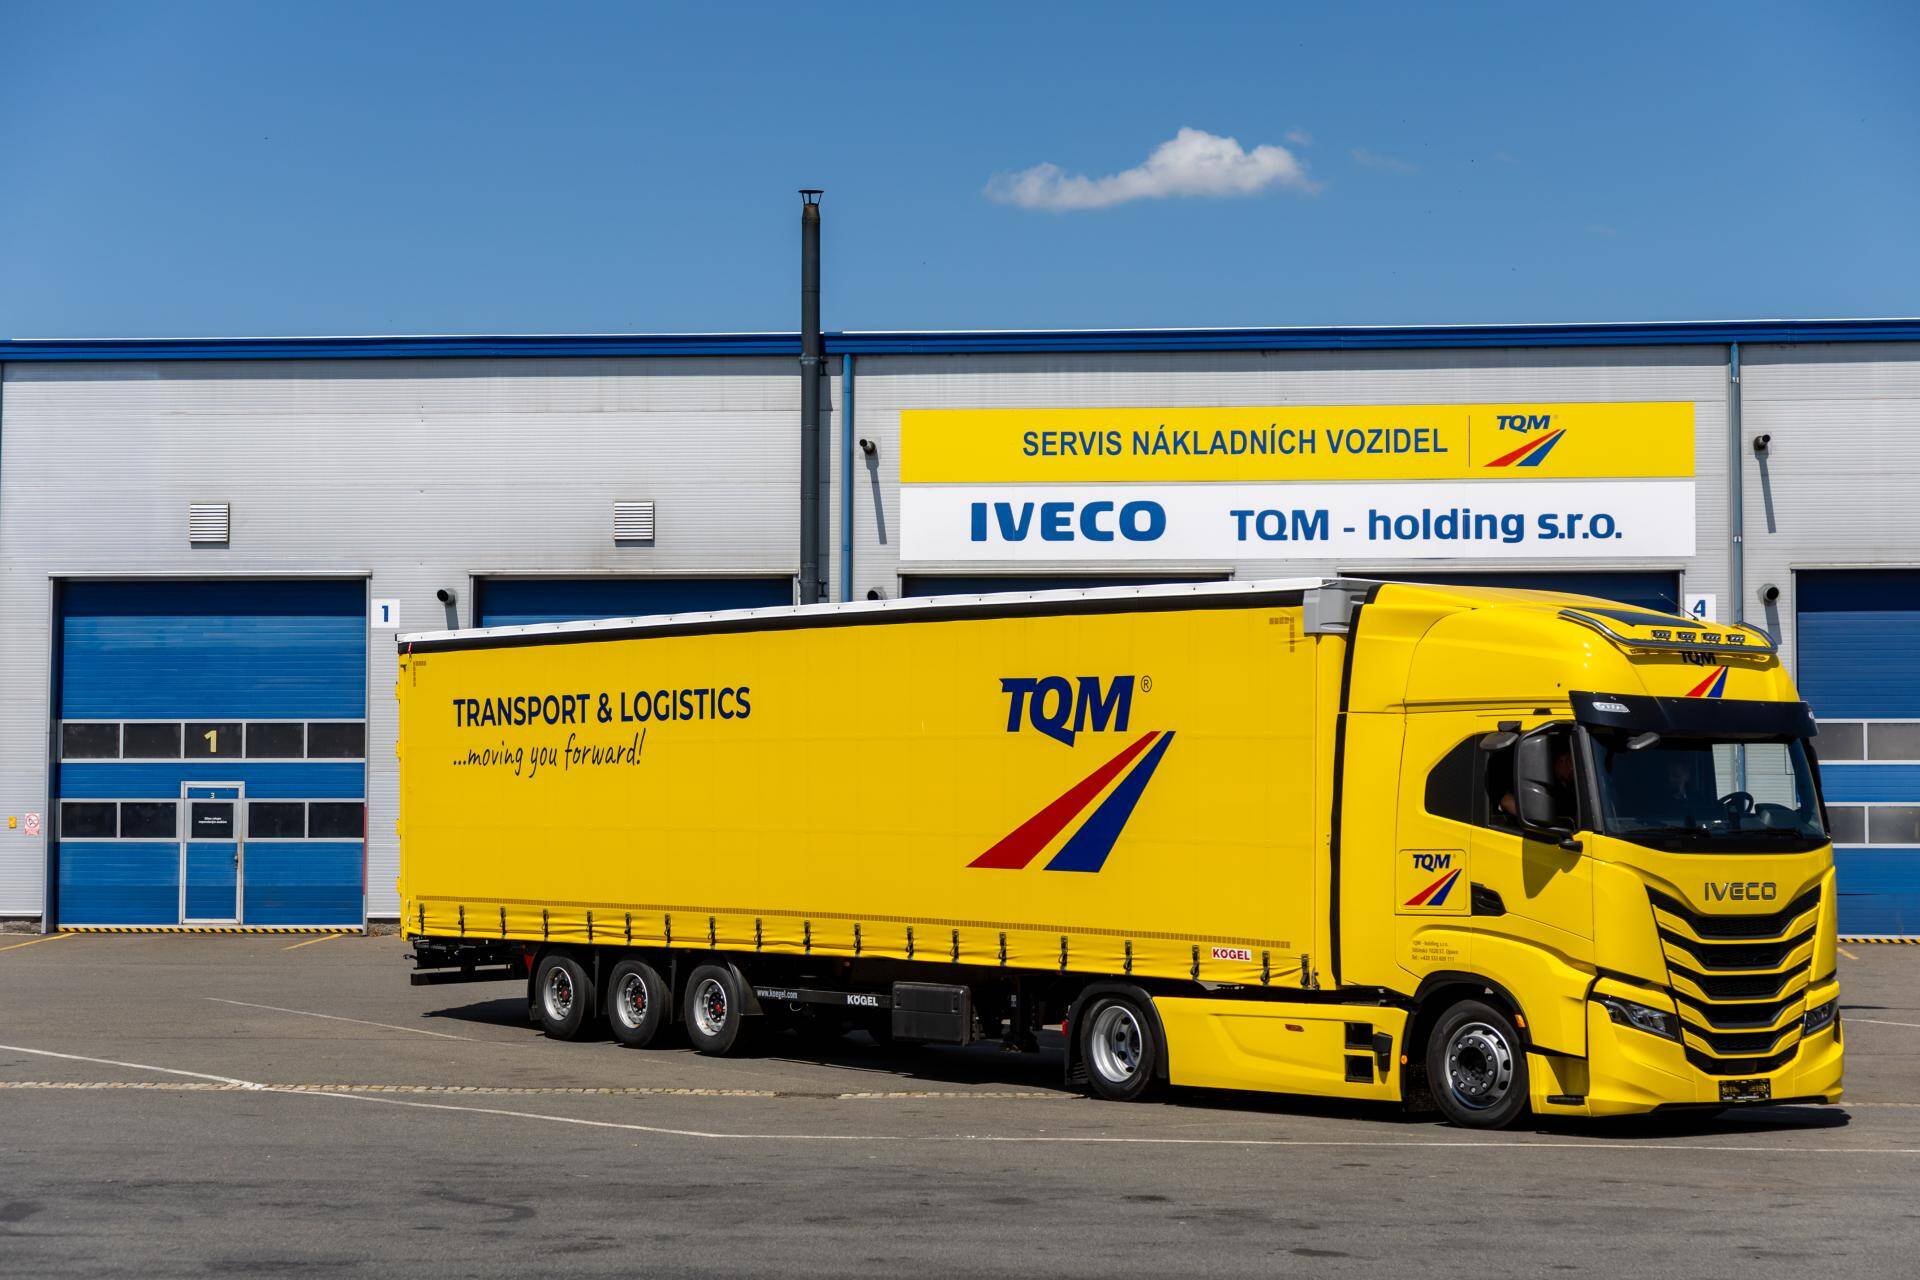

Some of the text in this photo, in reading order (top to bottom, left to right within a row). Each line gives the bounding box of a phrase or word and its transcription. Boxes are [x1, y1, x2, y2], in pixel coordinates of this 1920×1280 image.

[1496, 415, 1551, 433] TQM
[1023, 424, 1449, 456] SERVIS NÁKLADNÍCH VOZIDEL
[971, 500, 1166, 541] IVECO
[1230, 509, 1329, 541] TQM
[1368, 508, 1525, 543] holding
[1537, 513, 1622, 539] s.r.o.
[381, 605, 389, 622] 1
[1692, 599, 1706, 617] 4
[453, 687, 751, 727] TRANSPORT & LOGISTICS
[999, 675, 1135, 748] TQM
[204, 730, 217, 753] 1
[528, 745, 558, 779] you
[565, 728, 646, 771] forward!
[1413, 853, 1451, 872] TQM
[1704, 882, 1776, 901] IVECO
[757, 989, 798, 1000] www.koegel.com
